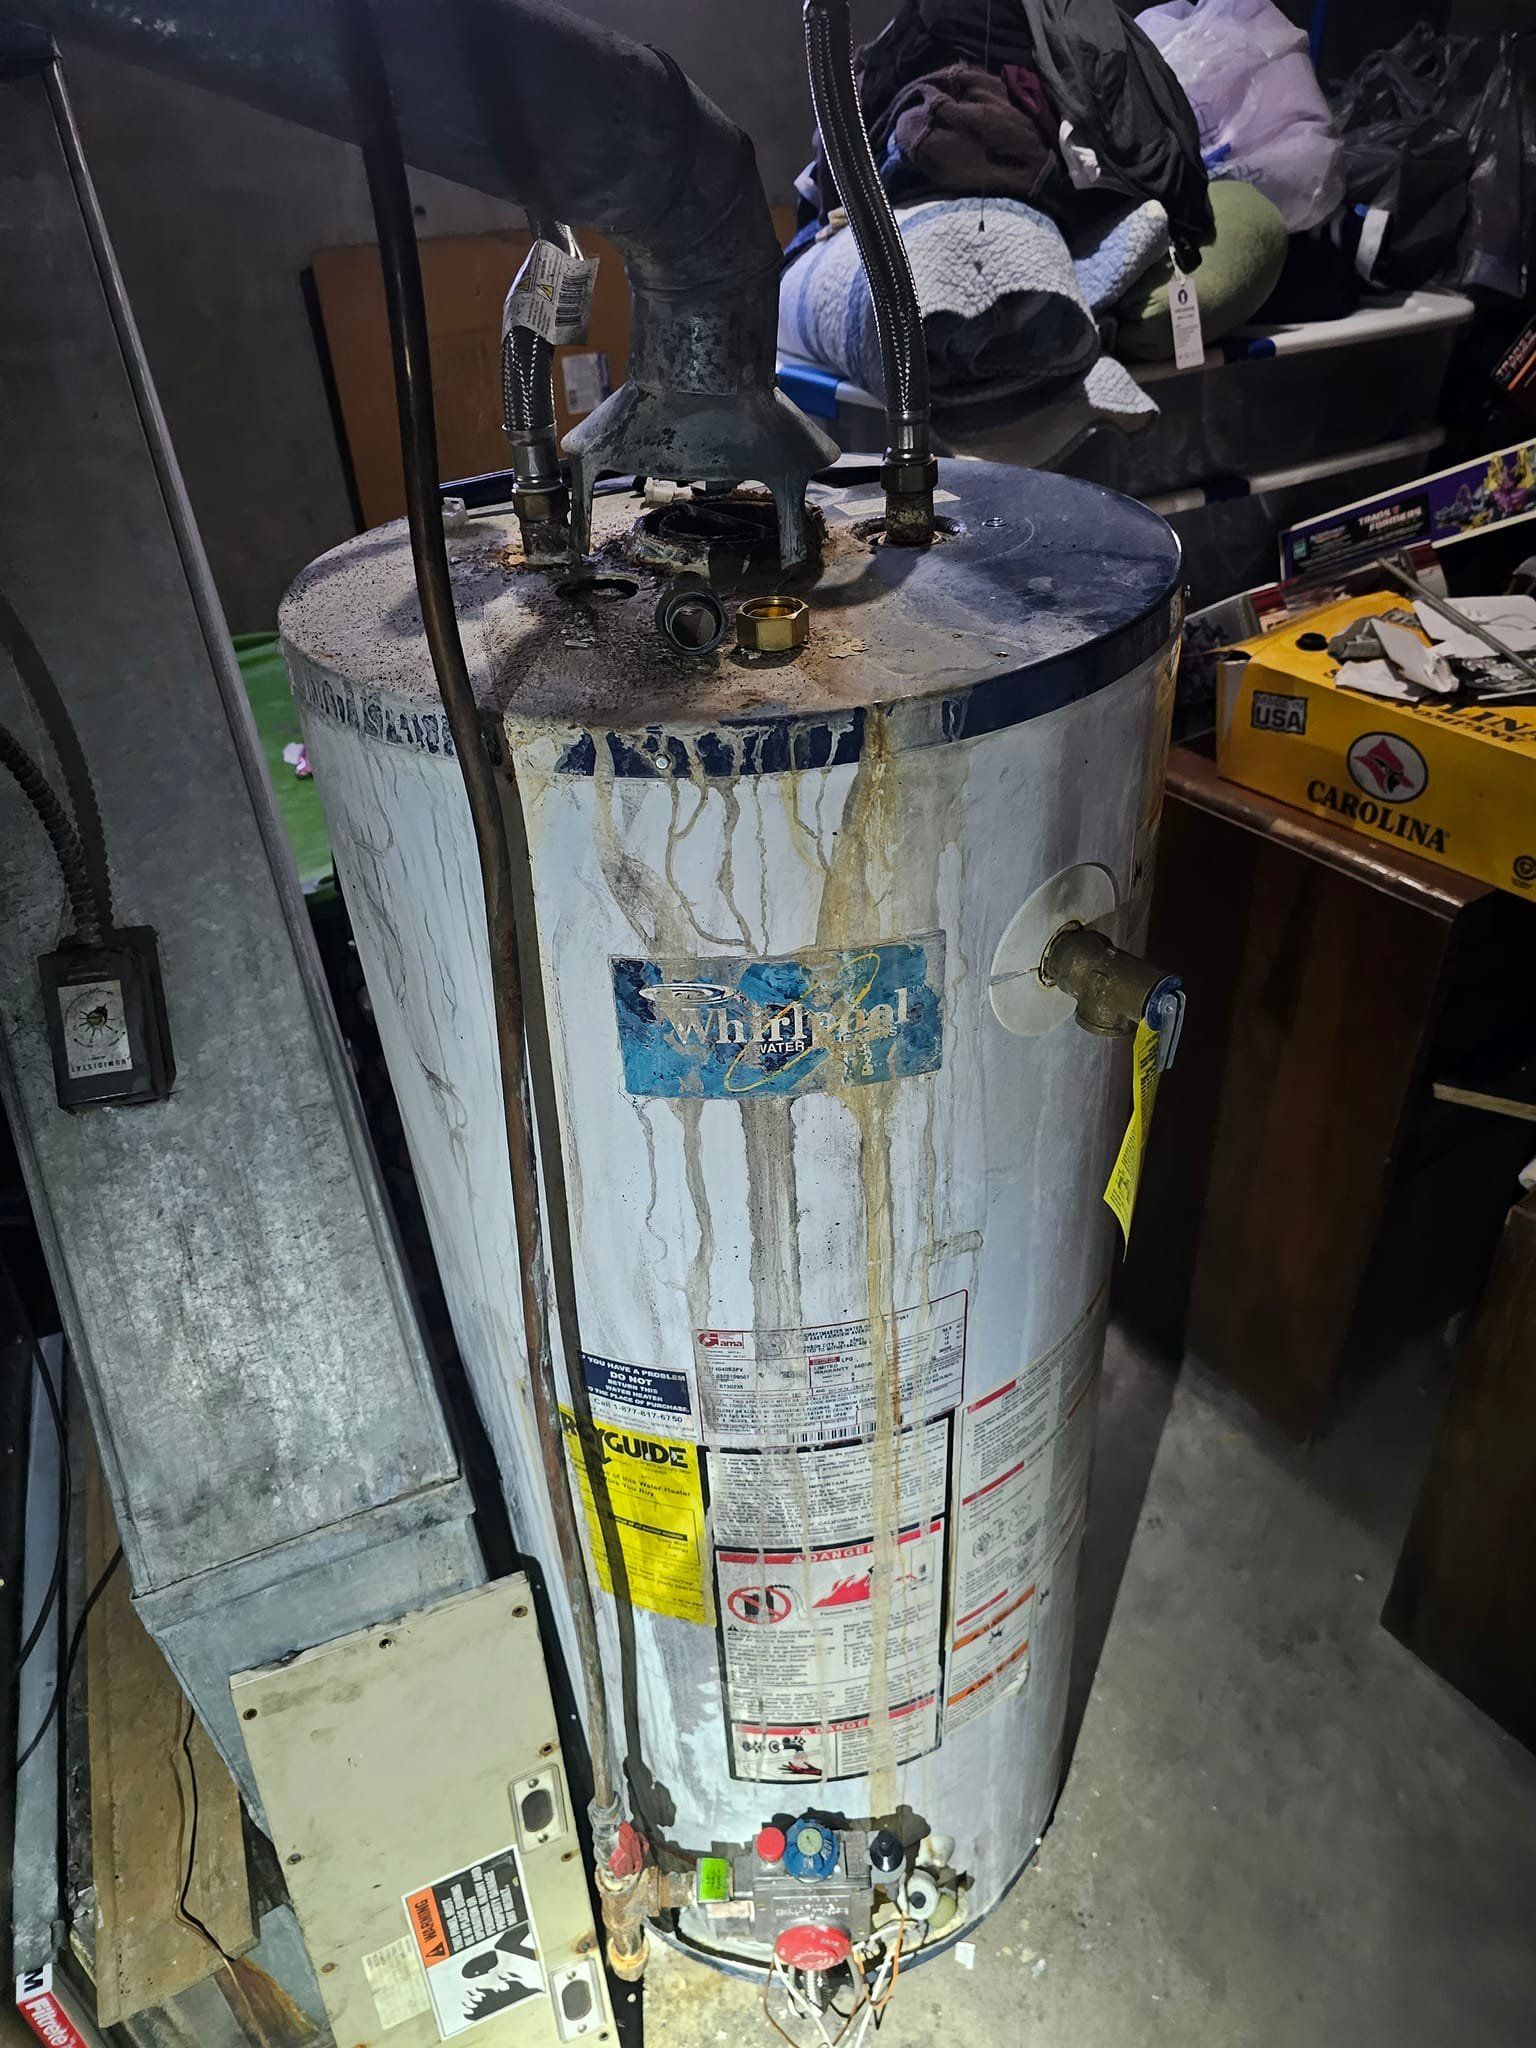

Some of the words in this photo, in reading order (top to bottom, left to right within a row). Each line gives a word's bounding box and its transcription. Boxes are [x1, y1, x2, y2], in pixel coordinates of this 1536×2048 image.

[1256, 708, 1301, 731] USA
[1307, 780, 1447, 852] CAROLINA
[760, 1041, 806, 1054] WATER
[588, 1356, 606, 1367] YOU
[607, 1362, 632, 1373] HAVE
[632, 1368, 640, 1376] A
[641, 1369, 686, 1382] PROBLEM
[607, 1379, 638, 1391] RETURN
[639, 1385, 659, 1395] THIS
[609, 1371, 626, 1381] DO
[628, 1375, 653, 1386] NOT
[595, 1387, 609, 1397] THE
[609, 1391, 634, 1404] PLACE
[634, 1397, 645, 1406] OF
[605, 1385, 632, 1397] WATER
[632, 1391, 664, 1403] HEATER
[593, 1398, 612, 1409] Call
[808, 1479, 848, 1489] IMPORTANT
[817, 1516, 859, 1526] CALIFORNIA
[415, 1898, 438, 1943] WARNING
[24, 1997, 70, 2047] Filtrete
